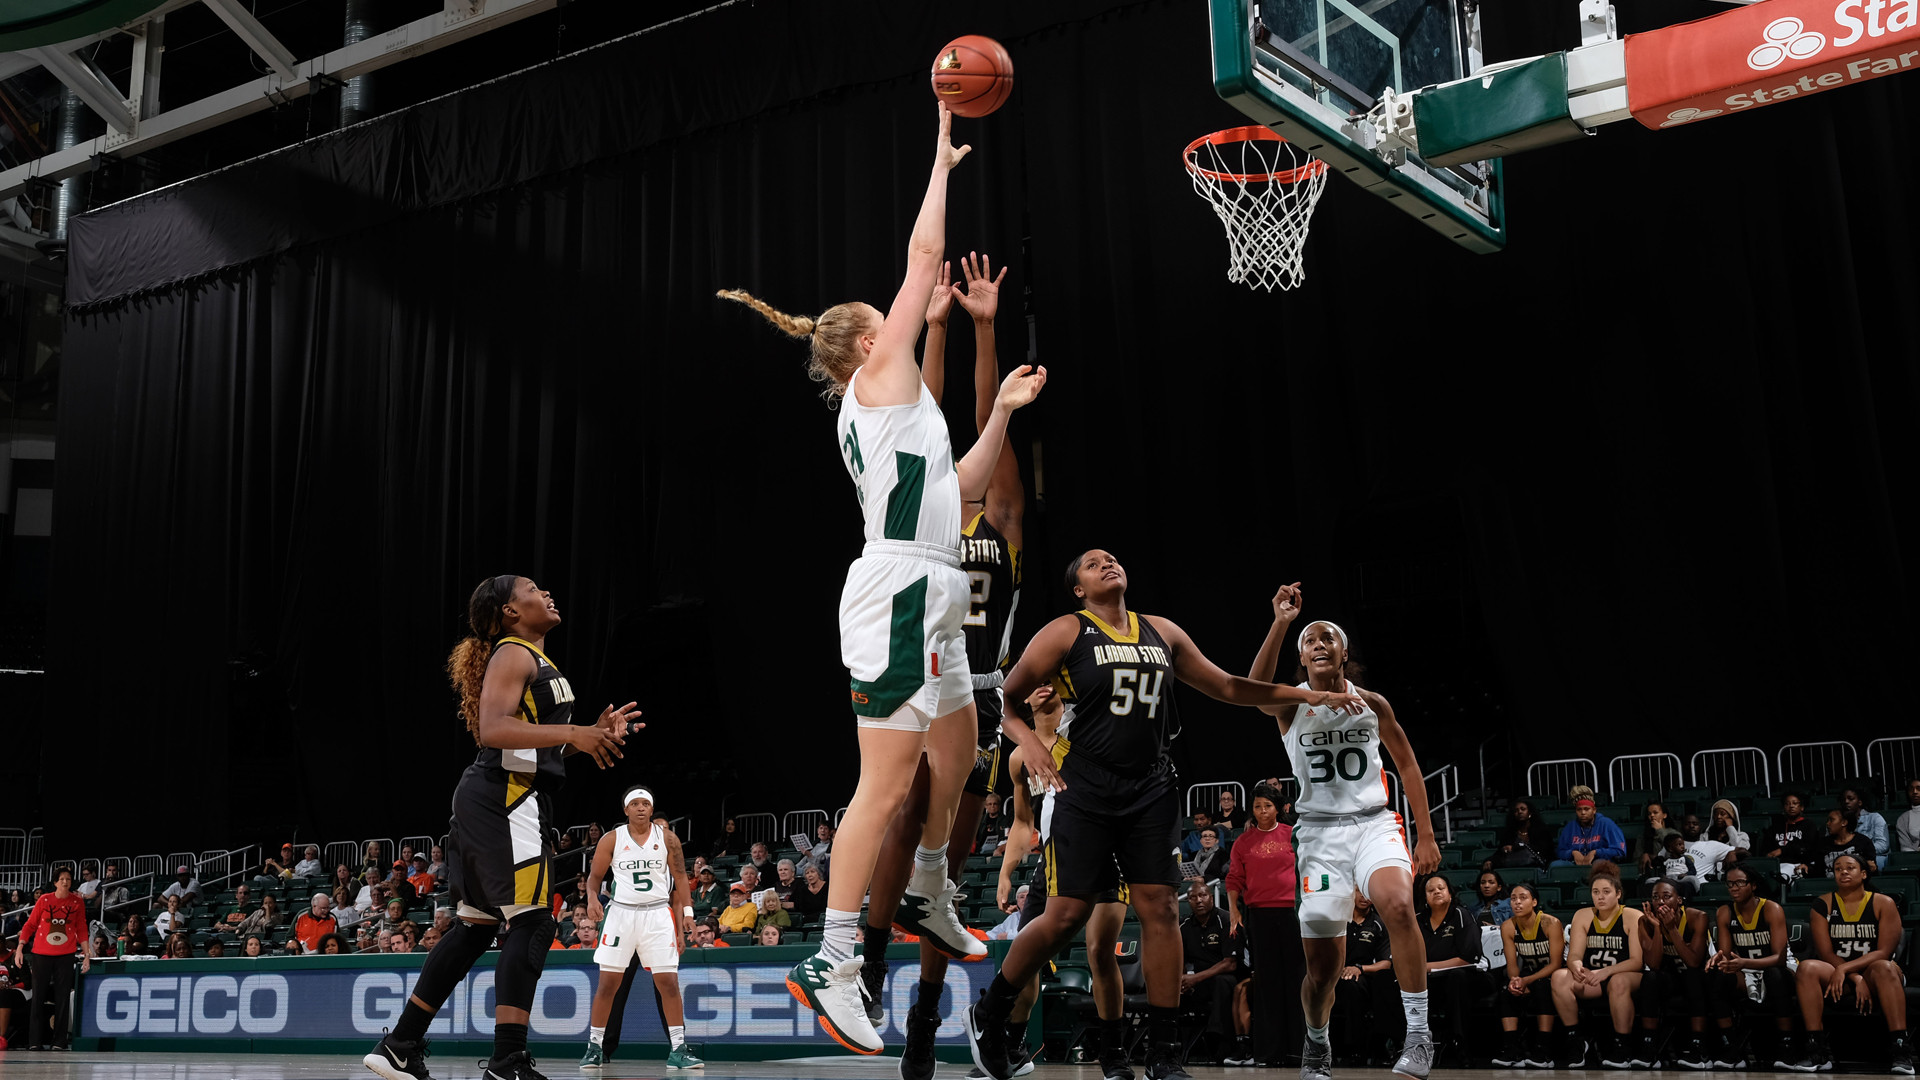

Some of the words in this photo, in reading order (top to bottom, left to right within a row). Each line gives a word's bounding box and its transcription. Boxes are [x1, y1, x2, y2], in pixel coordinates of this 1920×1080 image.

[1093, 644, 1141, 666] ALABAMA
[1138, 645, 1169, 667] STATE
[1109, 669, 1164, 719] 54
[1305, 747, 1368, 784] 30
[632, 871, 654, 892] 5
[1836, 940, 1871, 958] 34
[96, 974, 289, 1034] GEICO
[678, 963, 971, 1038] GEO
